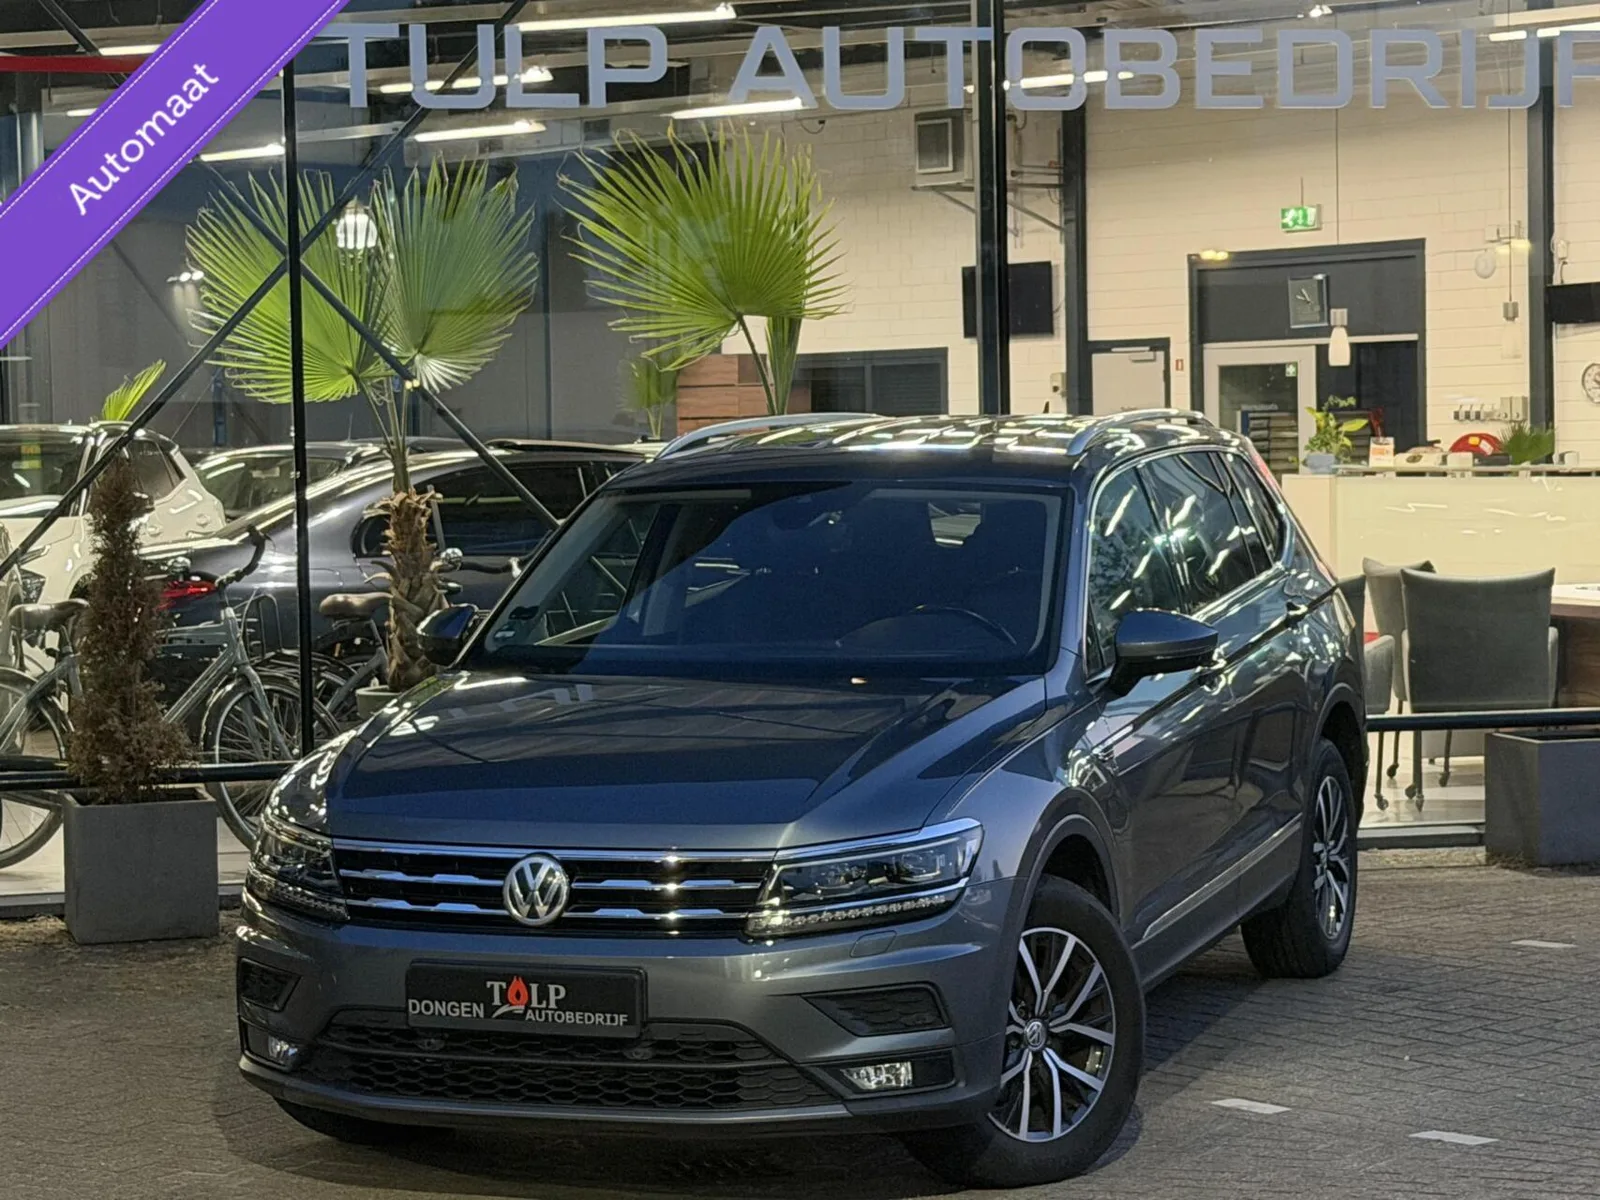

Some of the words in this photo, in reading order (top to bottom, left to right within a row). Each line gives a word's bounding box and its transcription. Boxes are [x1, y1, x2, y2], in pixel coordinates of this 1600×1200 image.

[316, 23, 668, 110] TULP
[408, 998, 485, 1019] DONGEN
[525, 1009, 628, 1027] AUTOBEDRIJF
